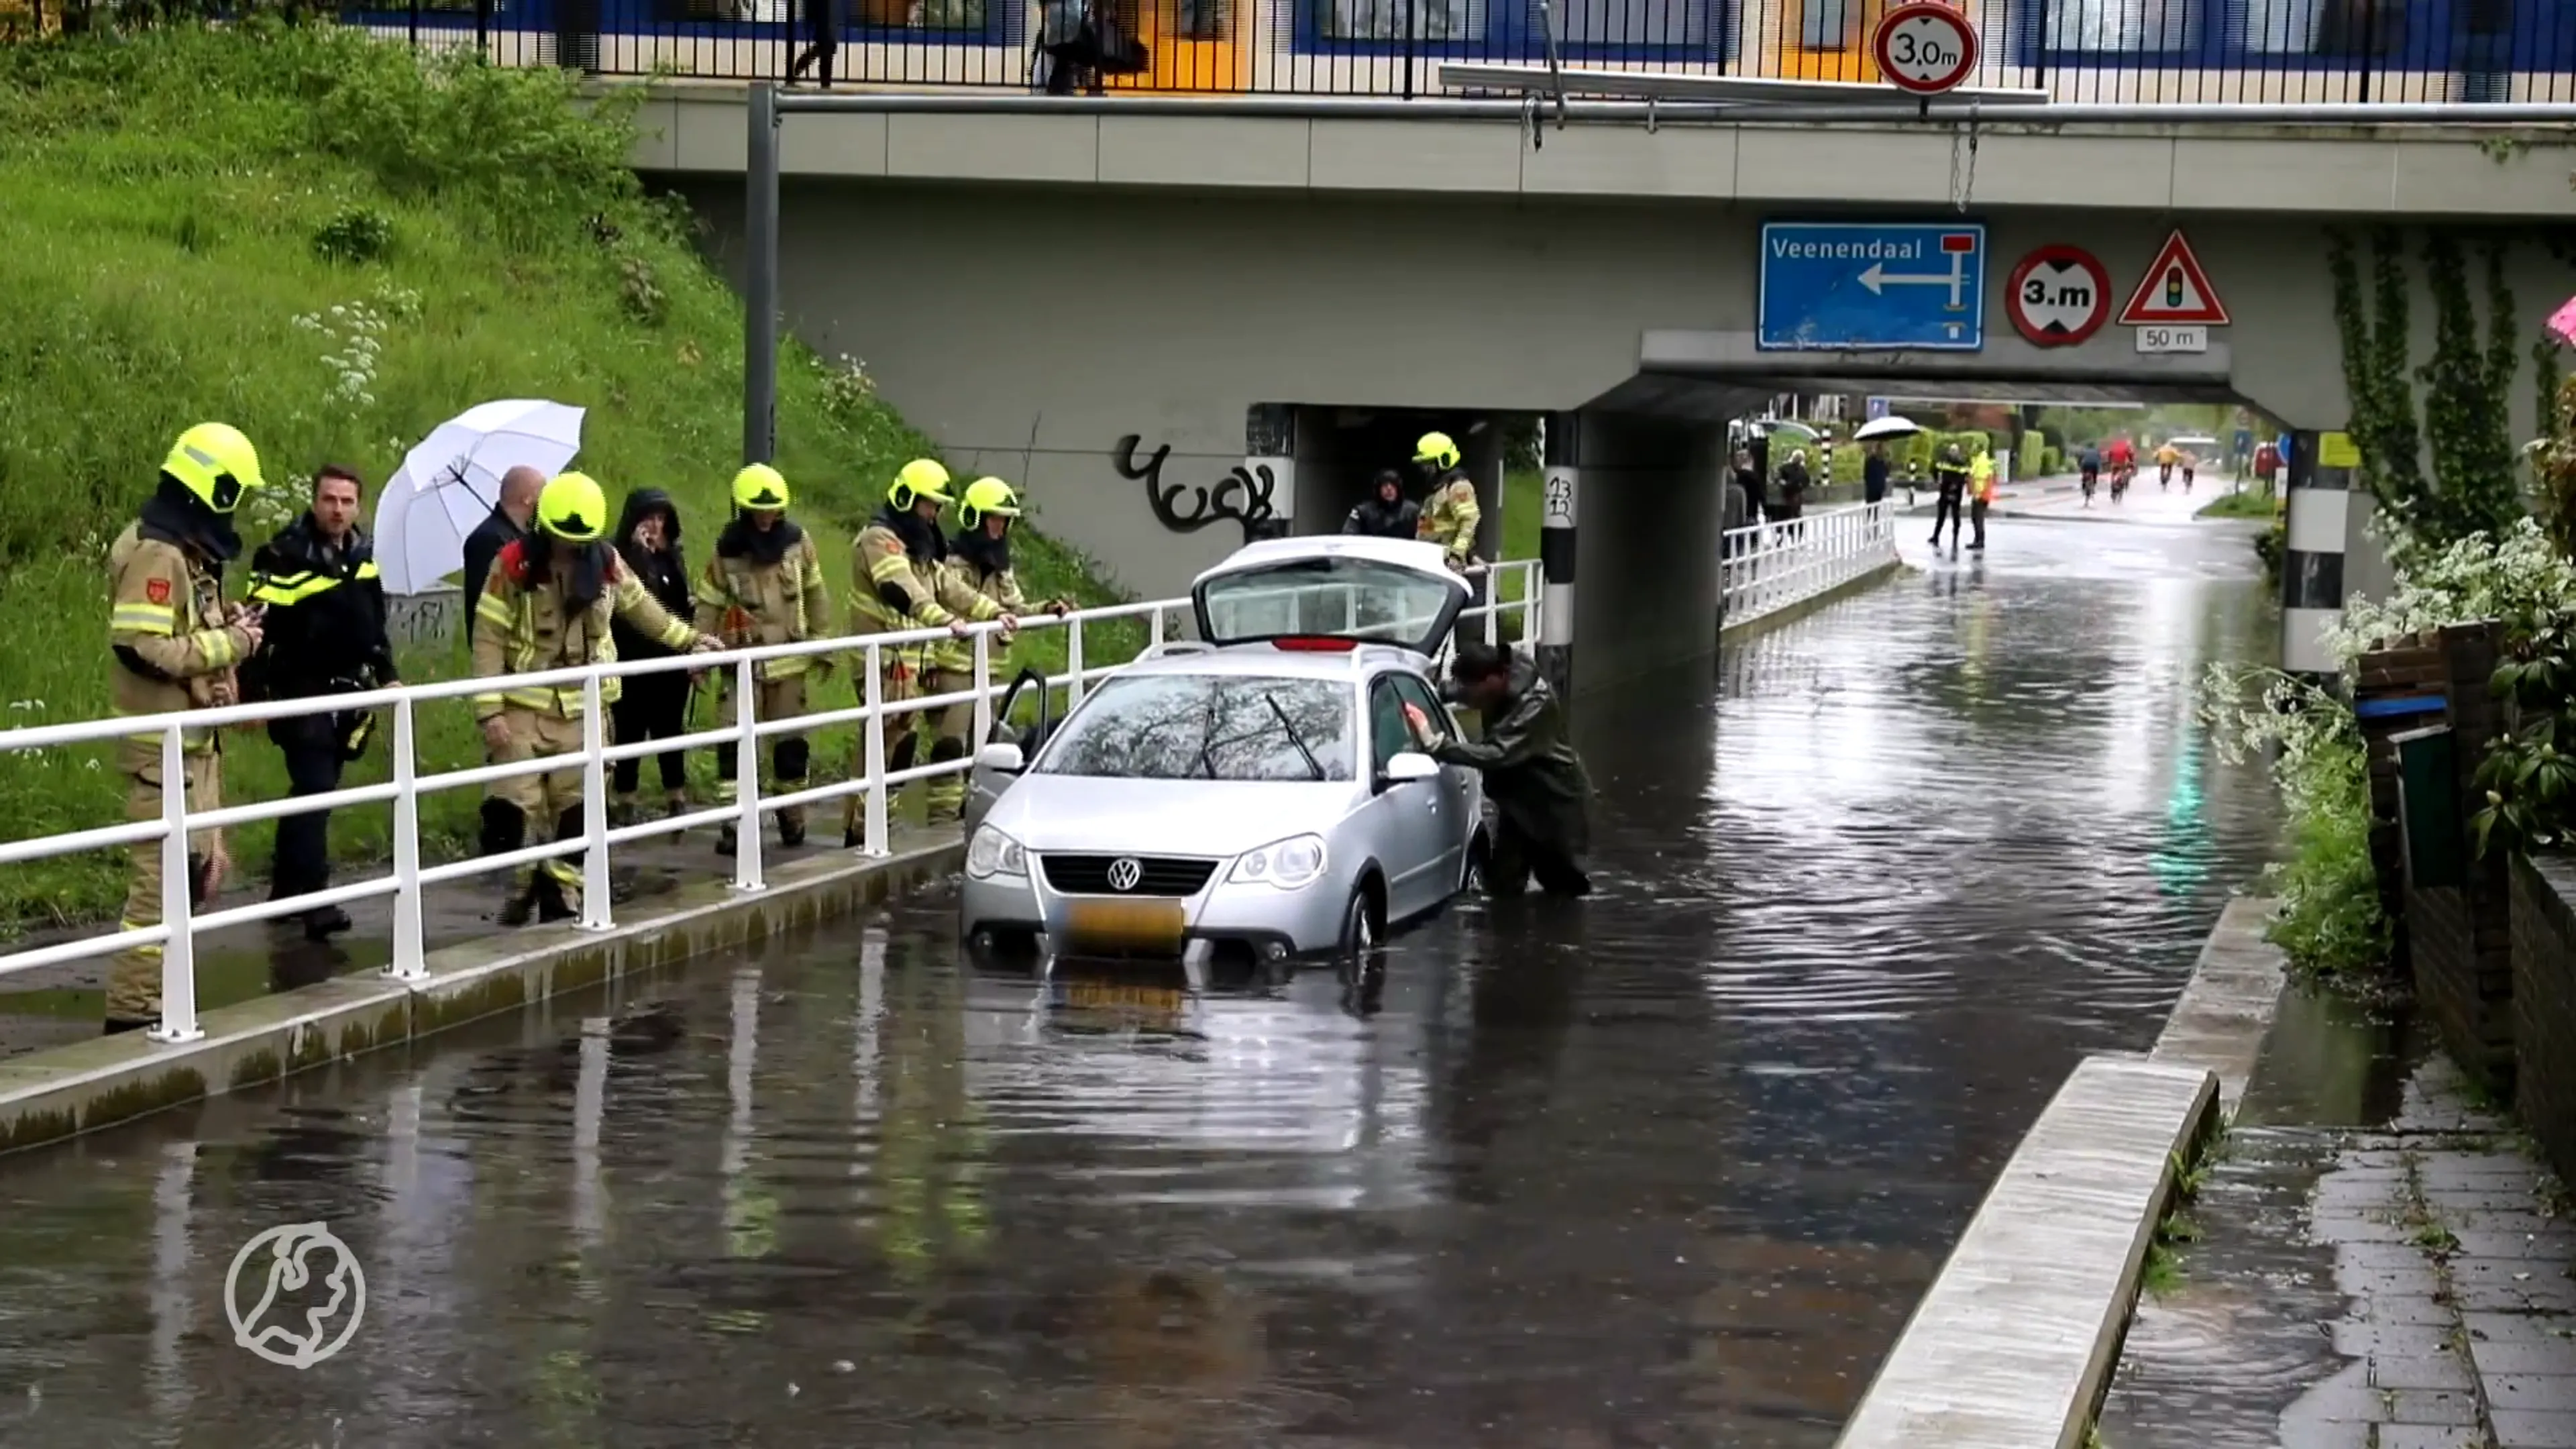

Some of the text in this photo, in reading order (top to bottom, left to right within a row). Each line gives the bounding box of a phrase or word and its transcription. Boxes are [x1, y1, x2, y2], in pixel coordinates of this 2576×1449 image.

[1894, 33, 1957, 66] 3.0m
[1772, 238, 1921, 259] Veenendaal
[2023, 279, 2090, 307] 3.m
[2147, 329, 2194, 347] 50 m
[1108, 858, 1140, 891] VW
